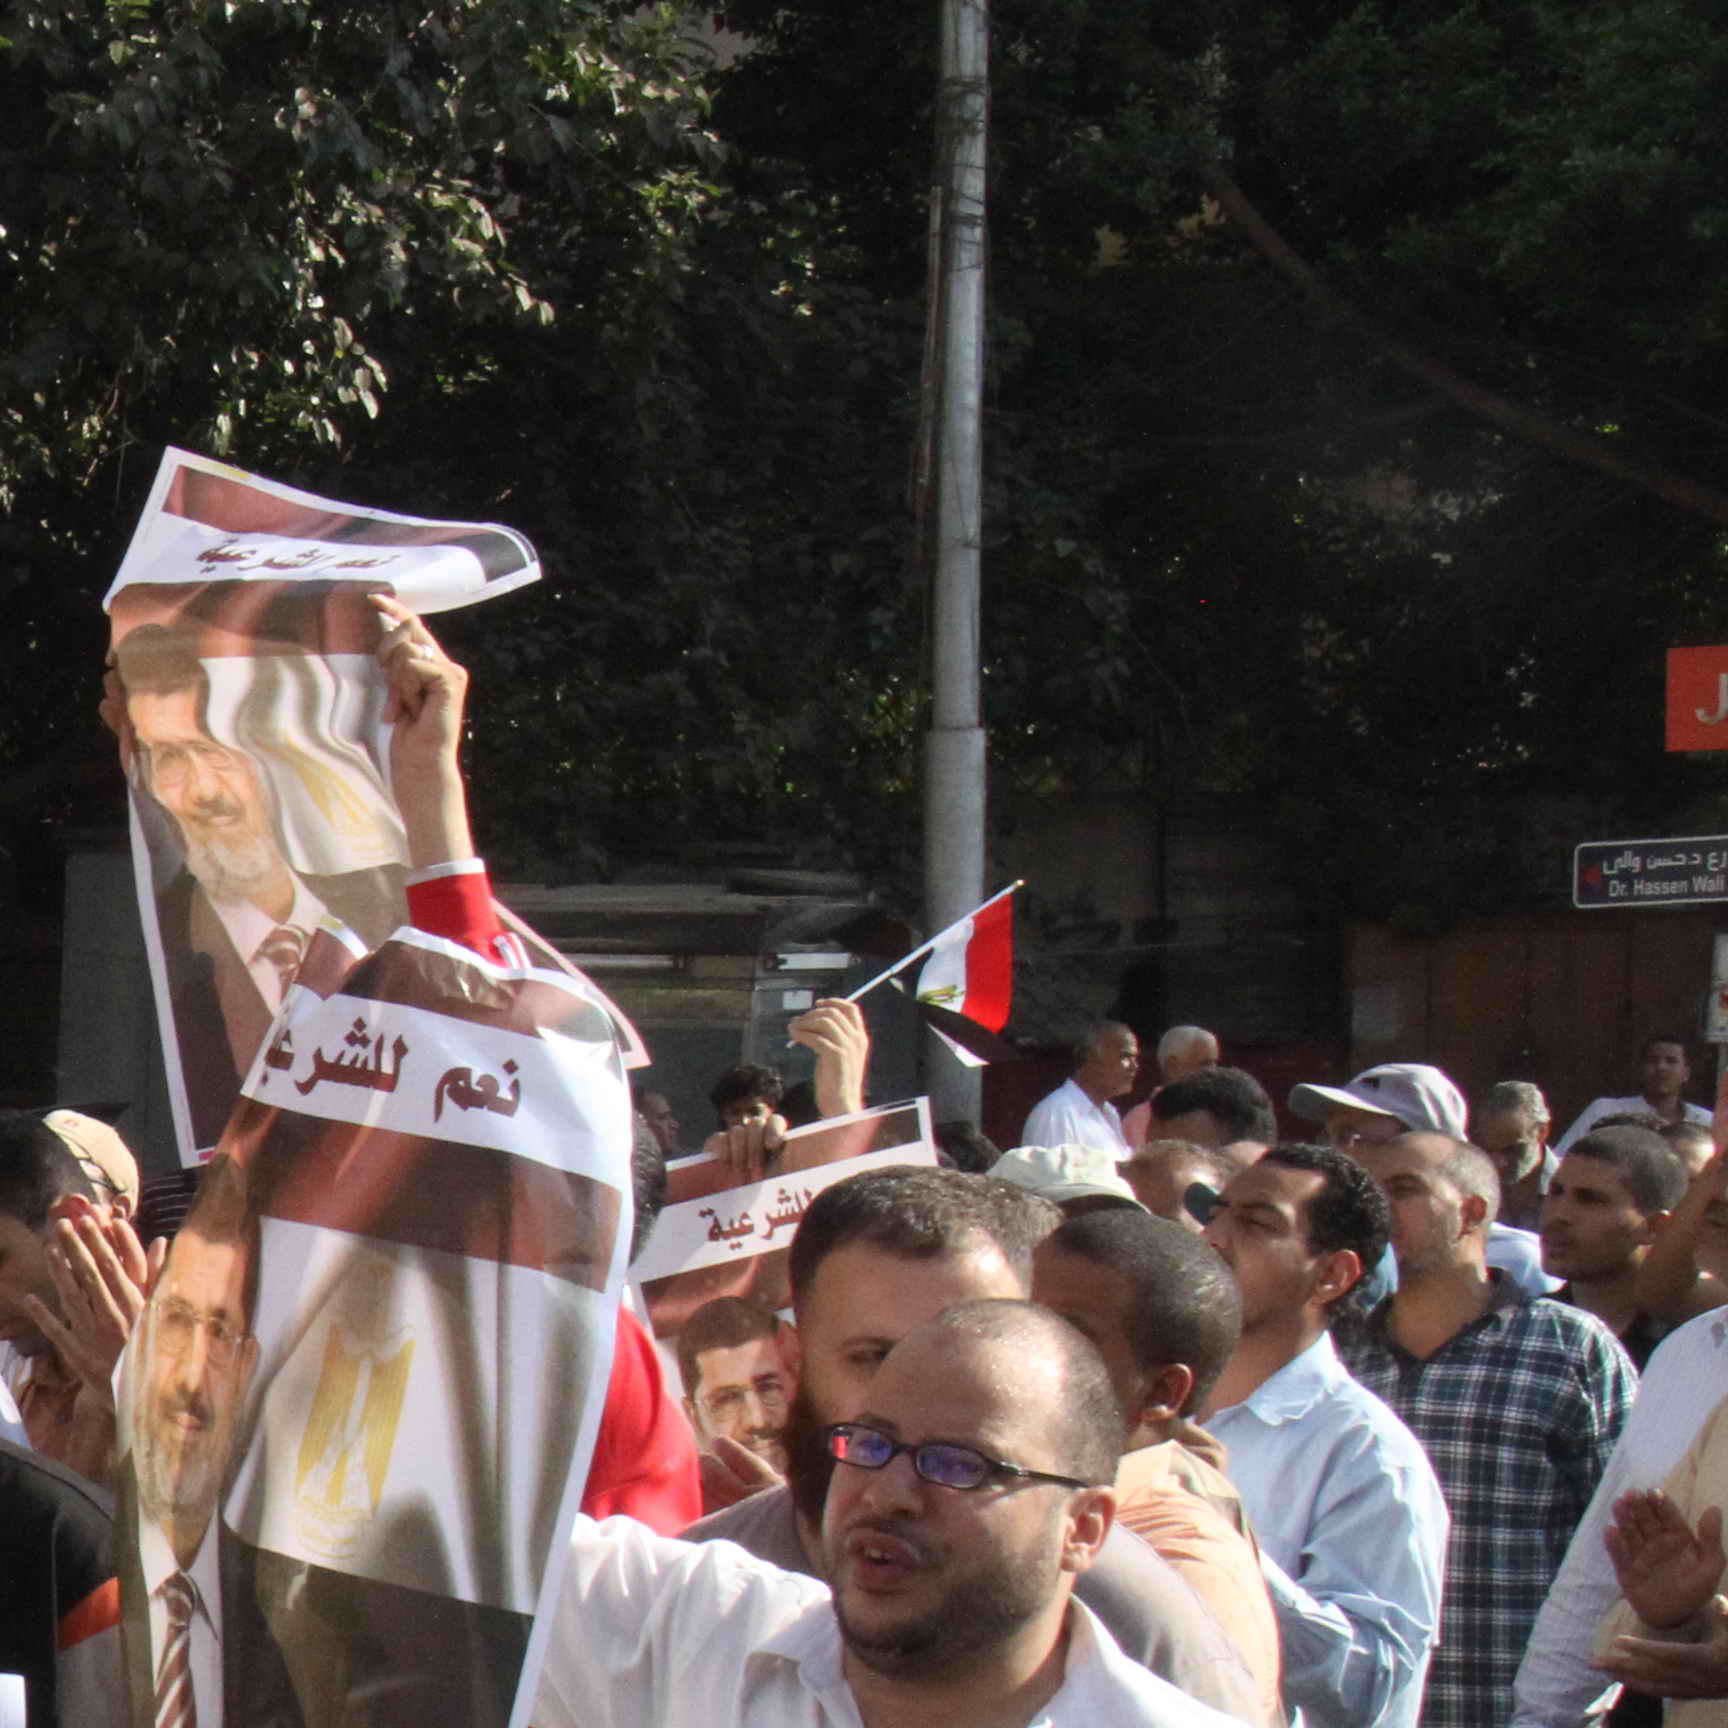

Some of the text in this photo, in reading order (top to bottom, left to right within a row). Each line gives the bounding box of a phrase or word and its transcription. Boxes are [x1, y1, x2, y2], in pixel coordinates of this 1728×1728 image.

[1608, 880, 1629, 898] Dr.
[1632, 879, 1689, 896] Hassen
[432, 1058, 521, 1124] نعم
